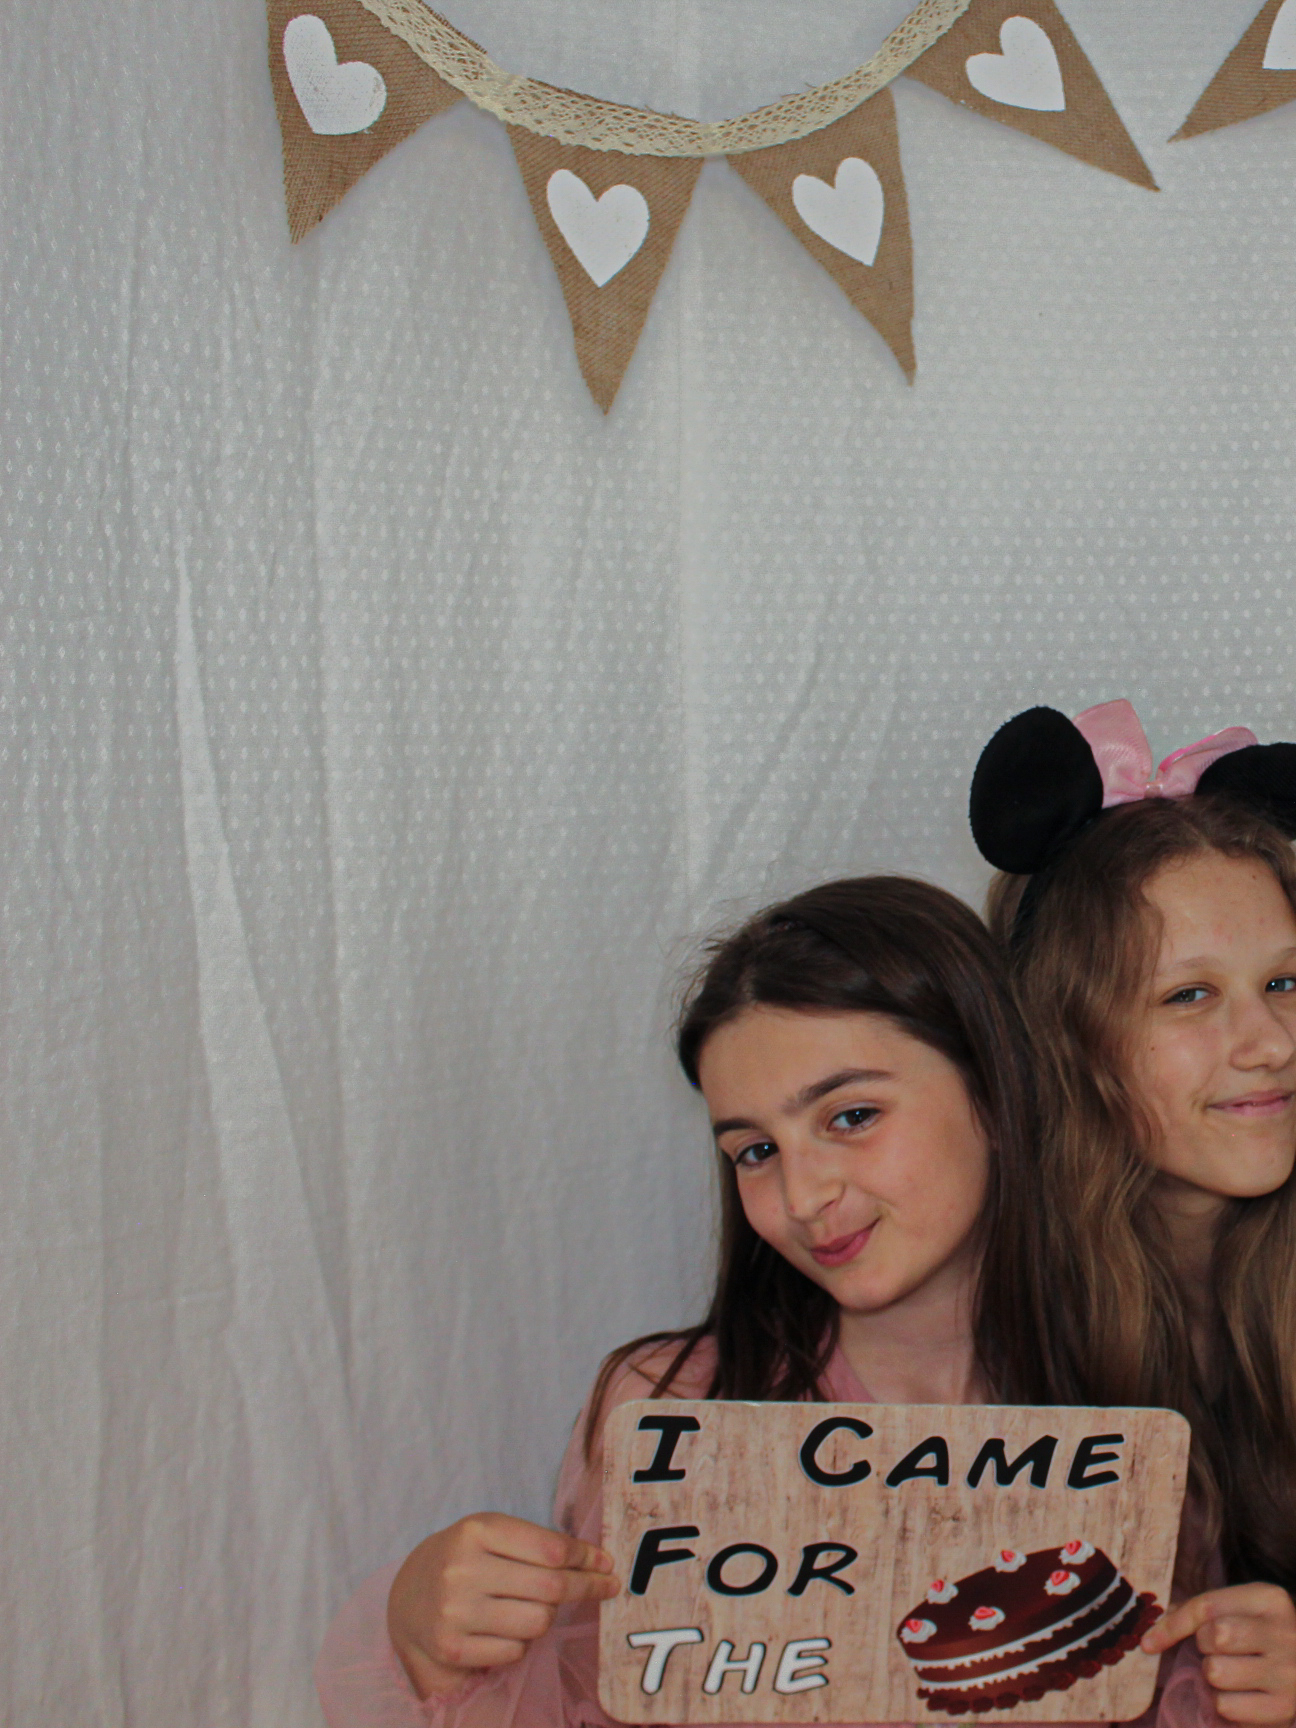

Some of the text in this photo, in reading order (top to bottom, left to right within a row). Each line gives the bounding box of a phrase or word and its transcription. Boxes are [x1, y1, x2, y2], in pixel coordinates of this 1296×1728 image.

[632, 1415, 1125, 1489] I CAME
[629, 1525, 858, 1597] FOR
[627, 1628, 832, 1695] THE
